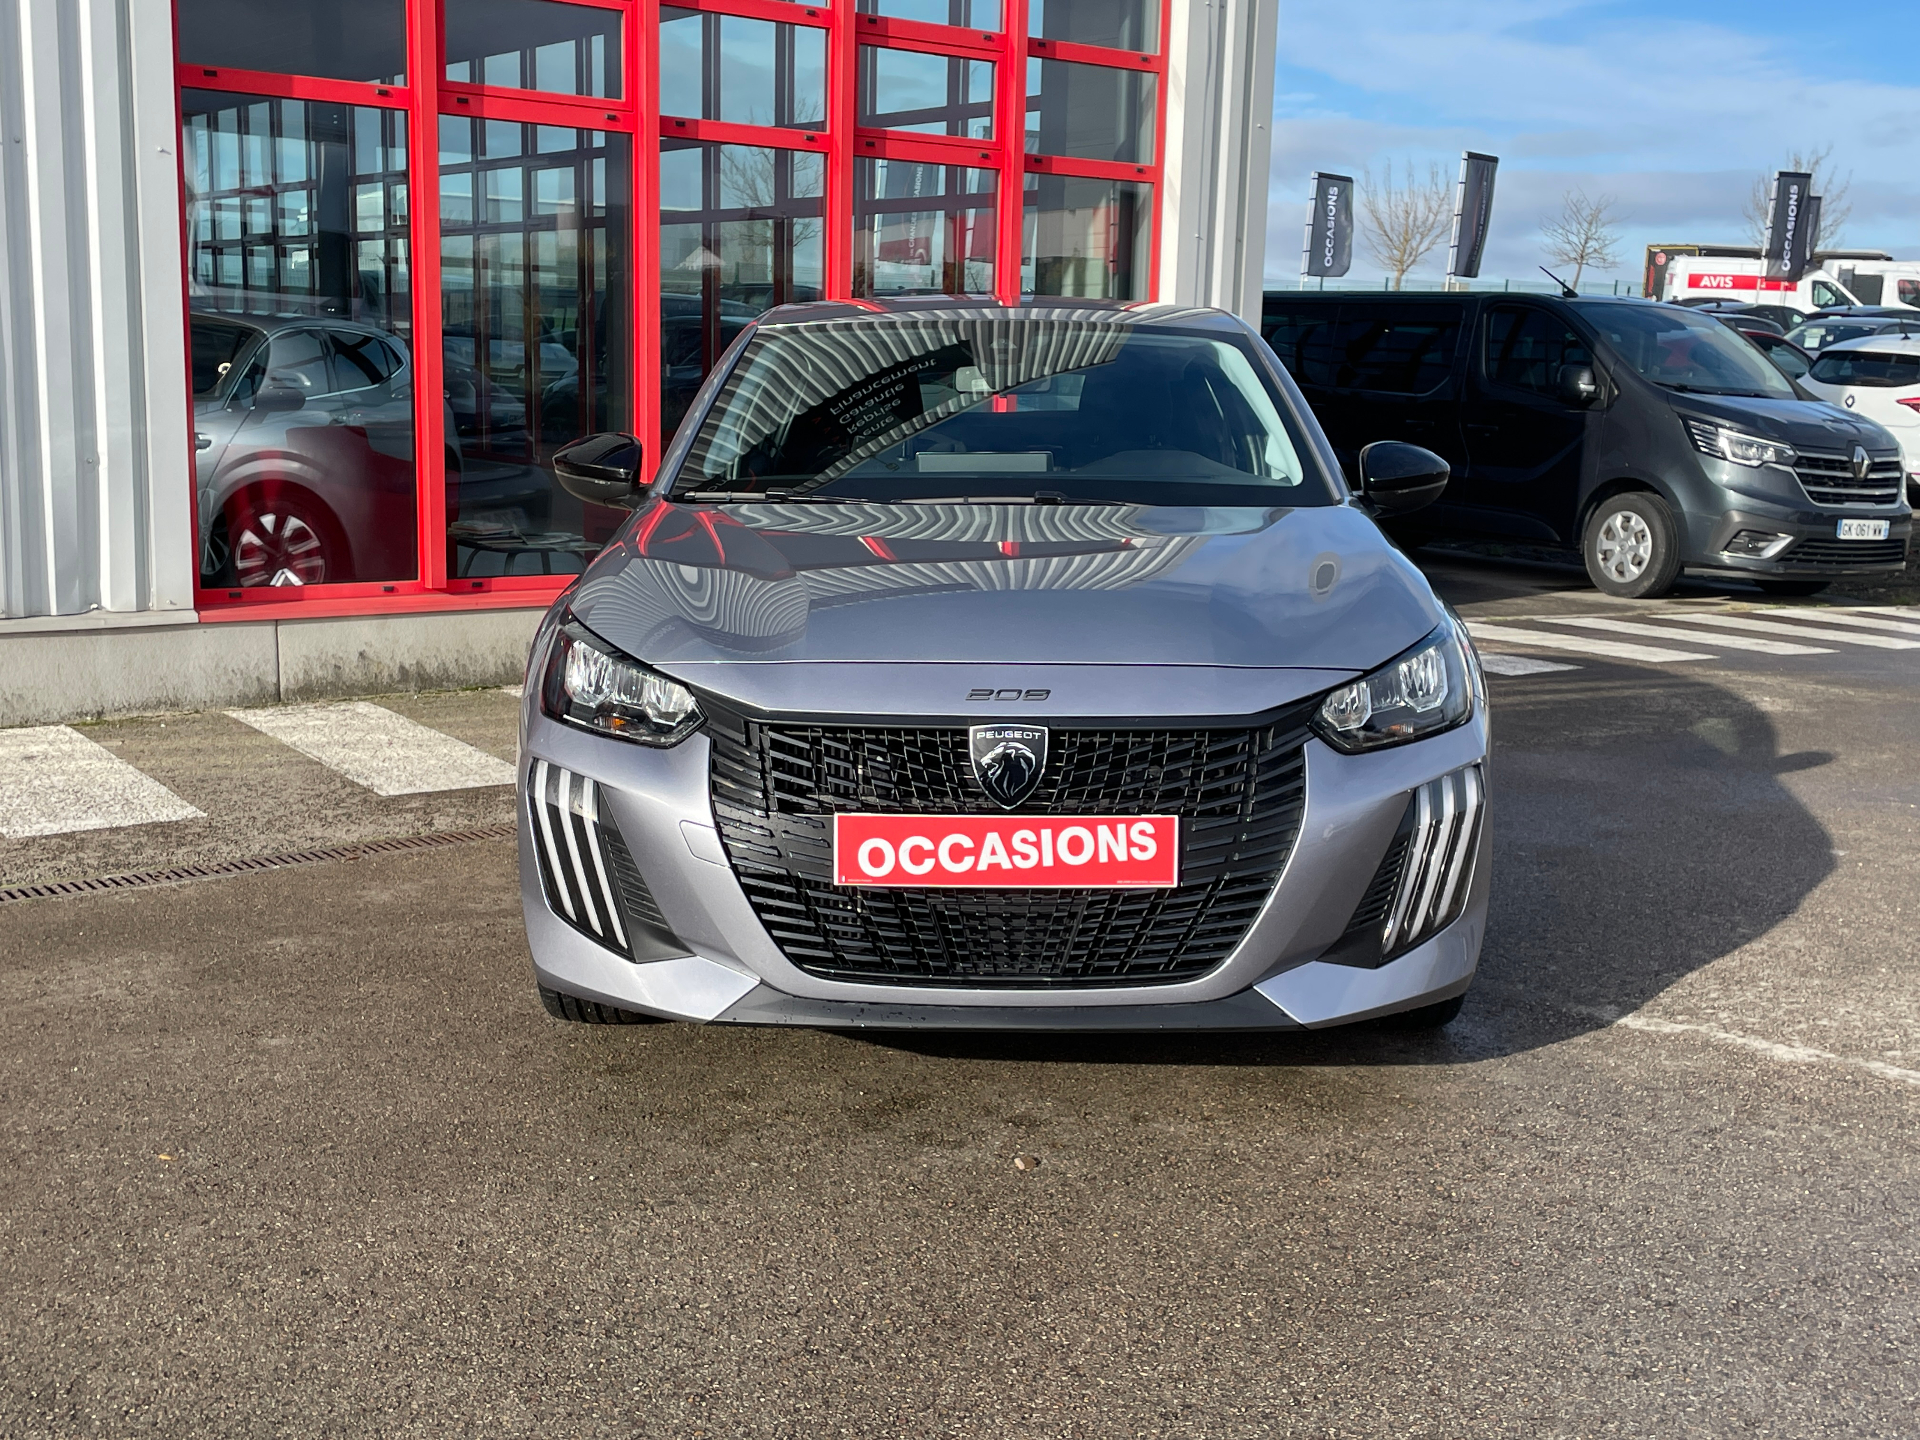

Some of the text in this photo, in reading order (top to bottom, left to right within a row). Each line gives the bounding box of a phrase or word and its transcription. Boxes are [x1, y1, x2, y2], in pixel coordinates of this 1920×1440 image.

[1323, 186, 1339, 267] OCCASIONS
[1781, 184, 1799, 271] OCCASIONS
[1700, 276, 1734, 288] AVIS
[965, 688, 1052, 701] 208
[976, 730, 1042, 740] PEUGEOT
[857, 821, 1158, 878] OCCASIONS
